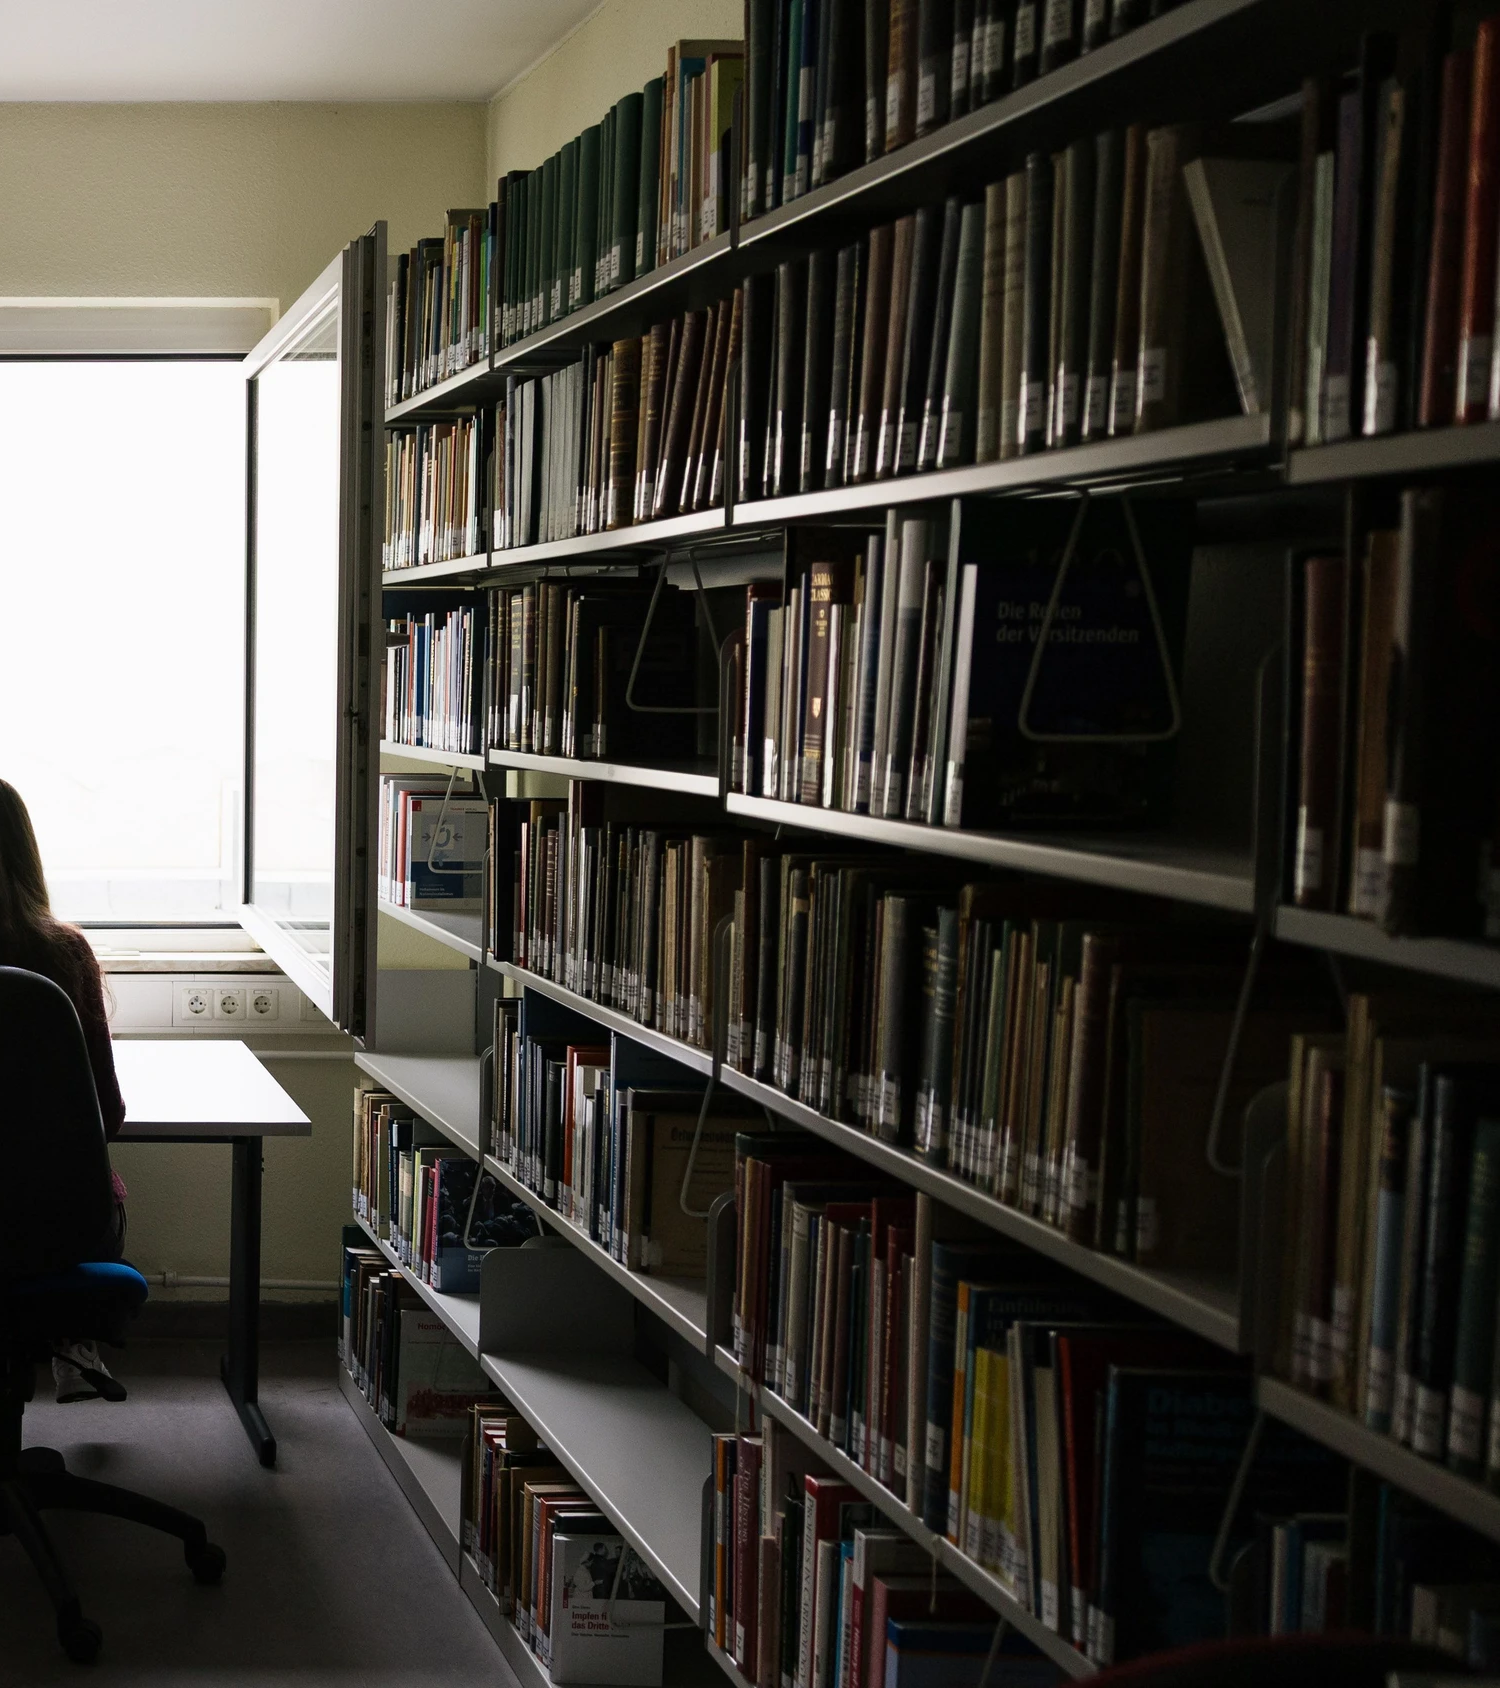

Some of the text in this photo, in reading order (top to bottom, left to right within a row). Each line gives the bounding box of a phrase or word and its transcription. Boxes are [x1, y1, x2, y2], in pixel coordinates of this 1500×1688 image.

[997, 601, 1025, 620] Die
[996, 624, 1140, 644] der Vrsitzenden
[1146, 1387, 1252, 1416] Diabe
[742, 1497, 750, 1545] HISTORY
[803, 1567, 812, 1581] IN
[572, 1611, 599, 1621] Impfen
[572, 1621, 609, 1630] das Dritte
